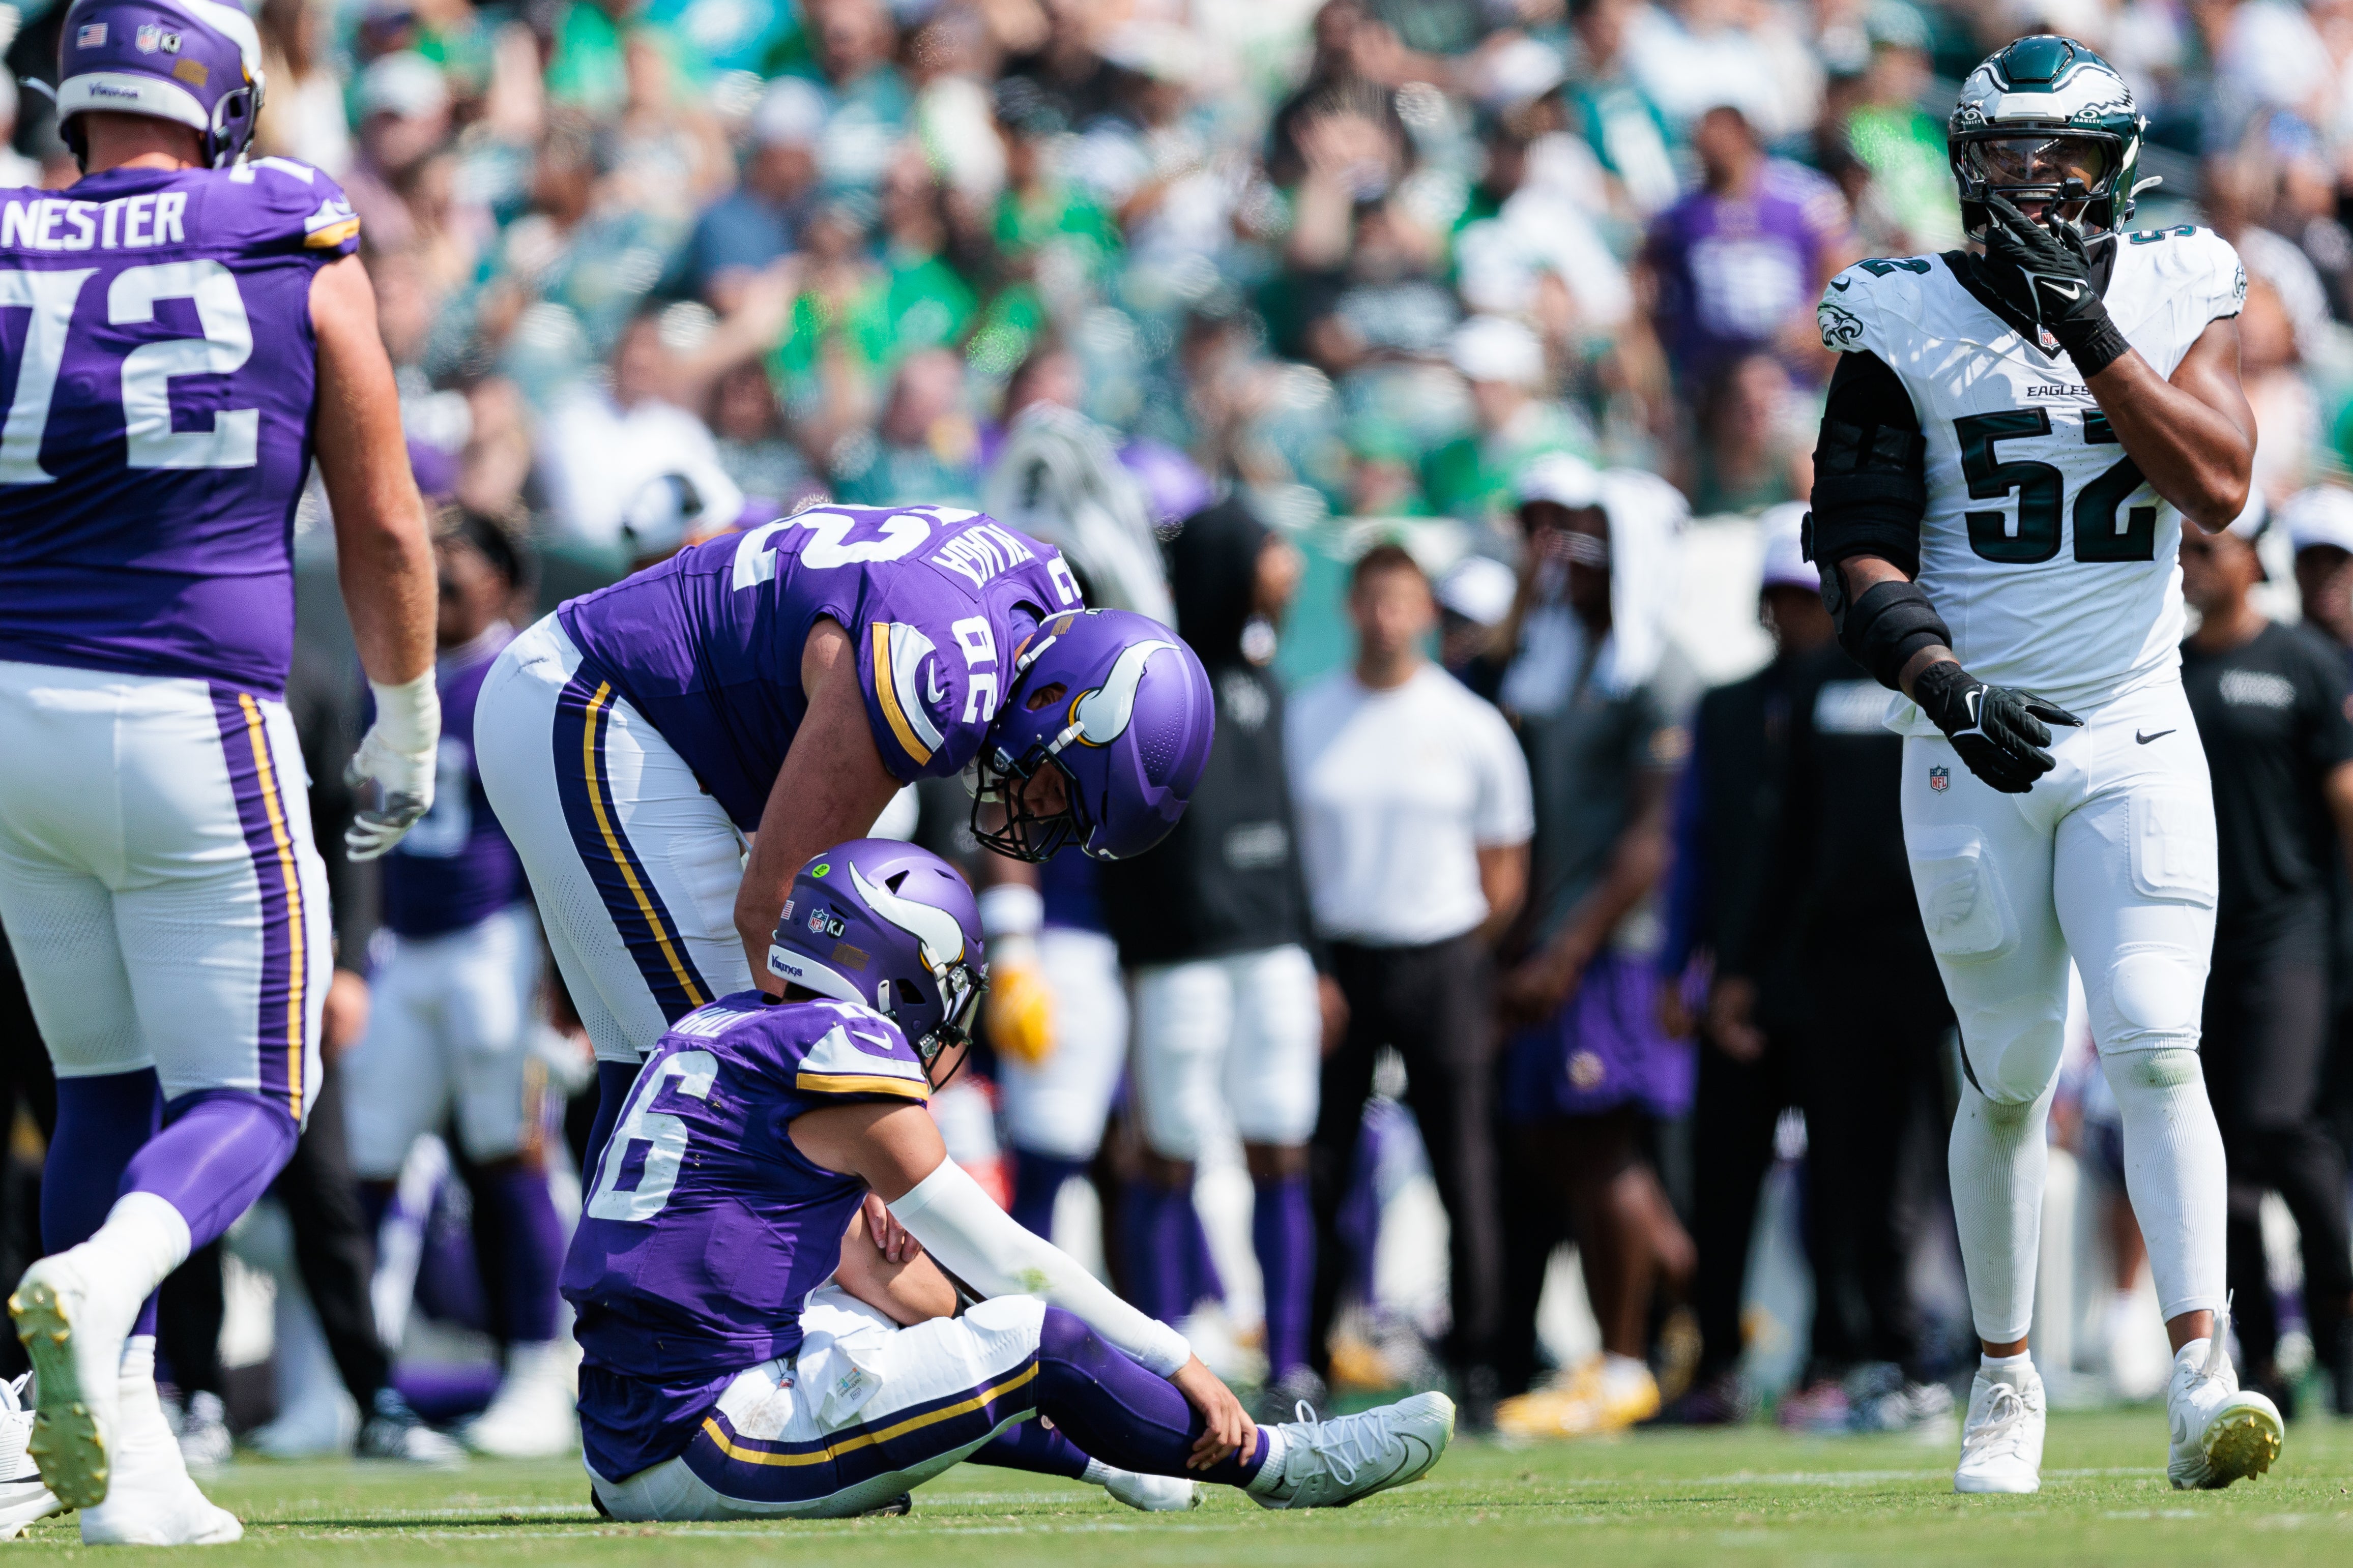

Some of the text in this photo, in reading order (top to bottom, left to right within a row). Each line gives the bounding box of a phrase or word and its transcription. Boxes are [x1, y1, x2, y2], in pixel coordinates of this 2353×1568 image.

[1, 191, 188, 251] NESTER
[0, 258, 259, 486] 72
[2026, 384, 2091, 397] EAGLES
[1952, 406, 2157, 565] 52
[1931, 777, 1947, 789] NFL
[810, 918, 822, 930] NFL
[826, 920, 845, 937] KJ
[671, 1007, 756, 1038] HALL
